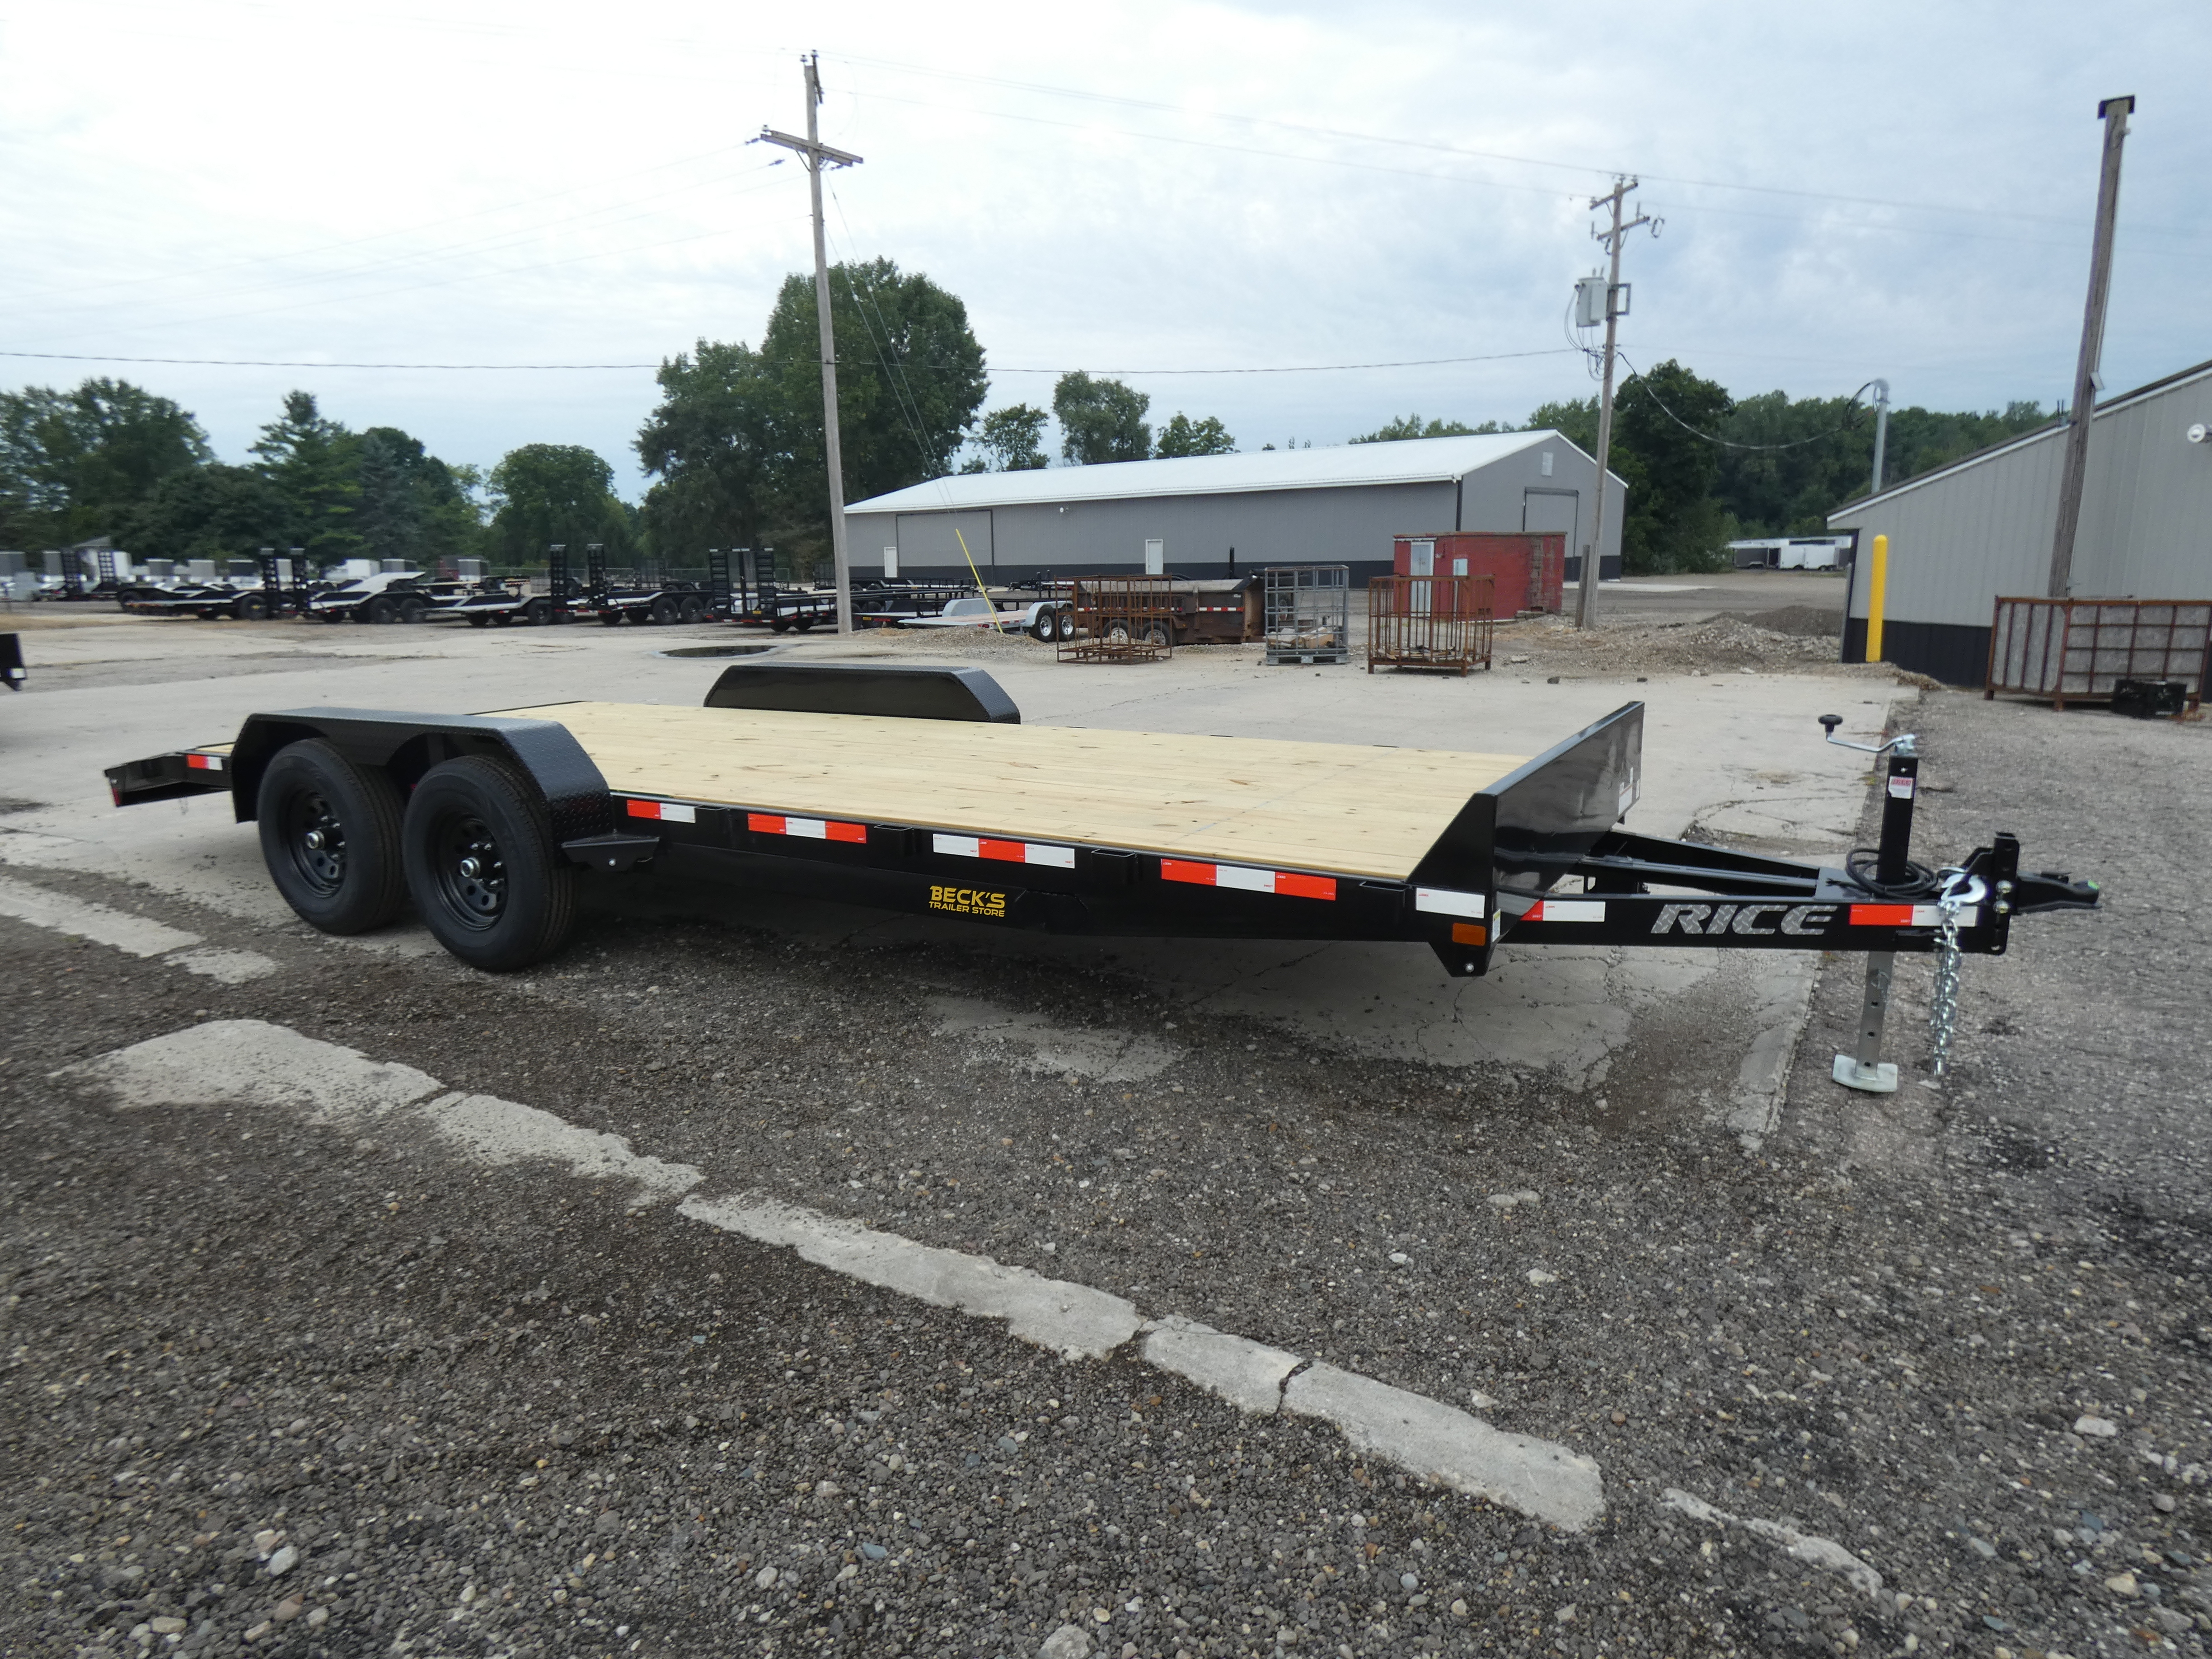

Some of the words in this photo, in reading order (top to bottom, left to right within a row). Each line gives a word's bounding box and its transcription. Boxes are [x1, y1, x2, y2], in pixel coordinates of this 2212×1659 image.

[929, 886, 1005, 909] BECK'S
[929, 901, 969, 913] TRAILER
[972, 907, 1005, 917] STORE
[1651, 904, 1837, 935] RICE
